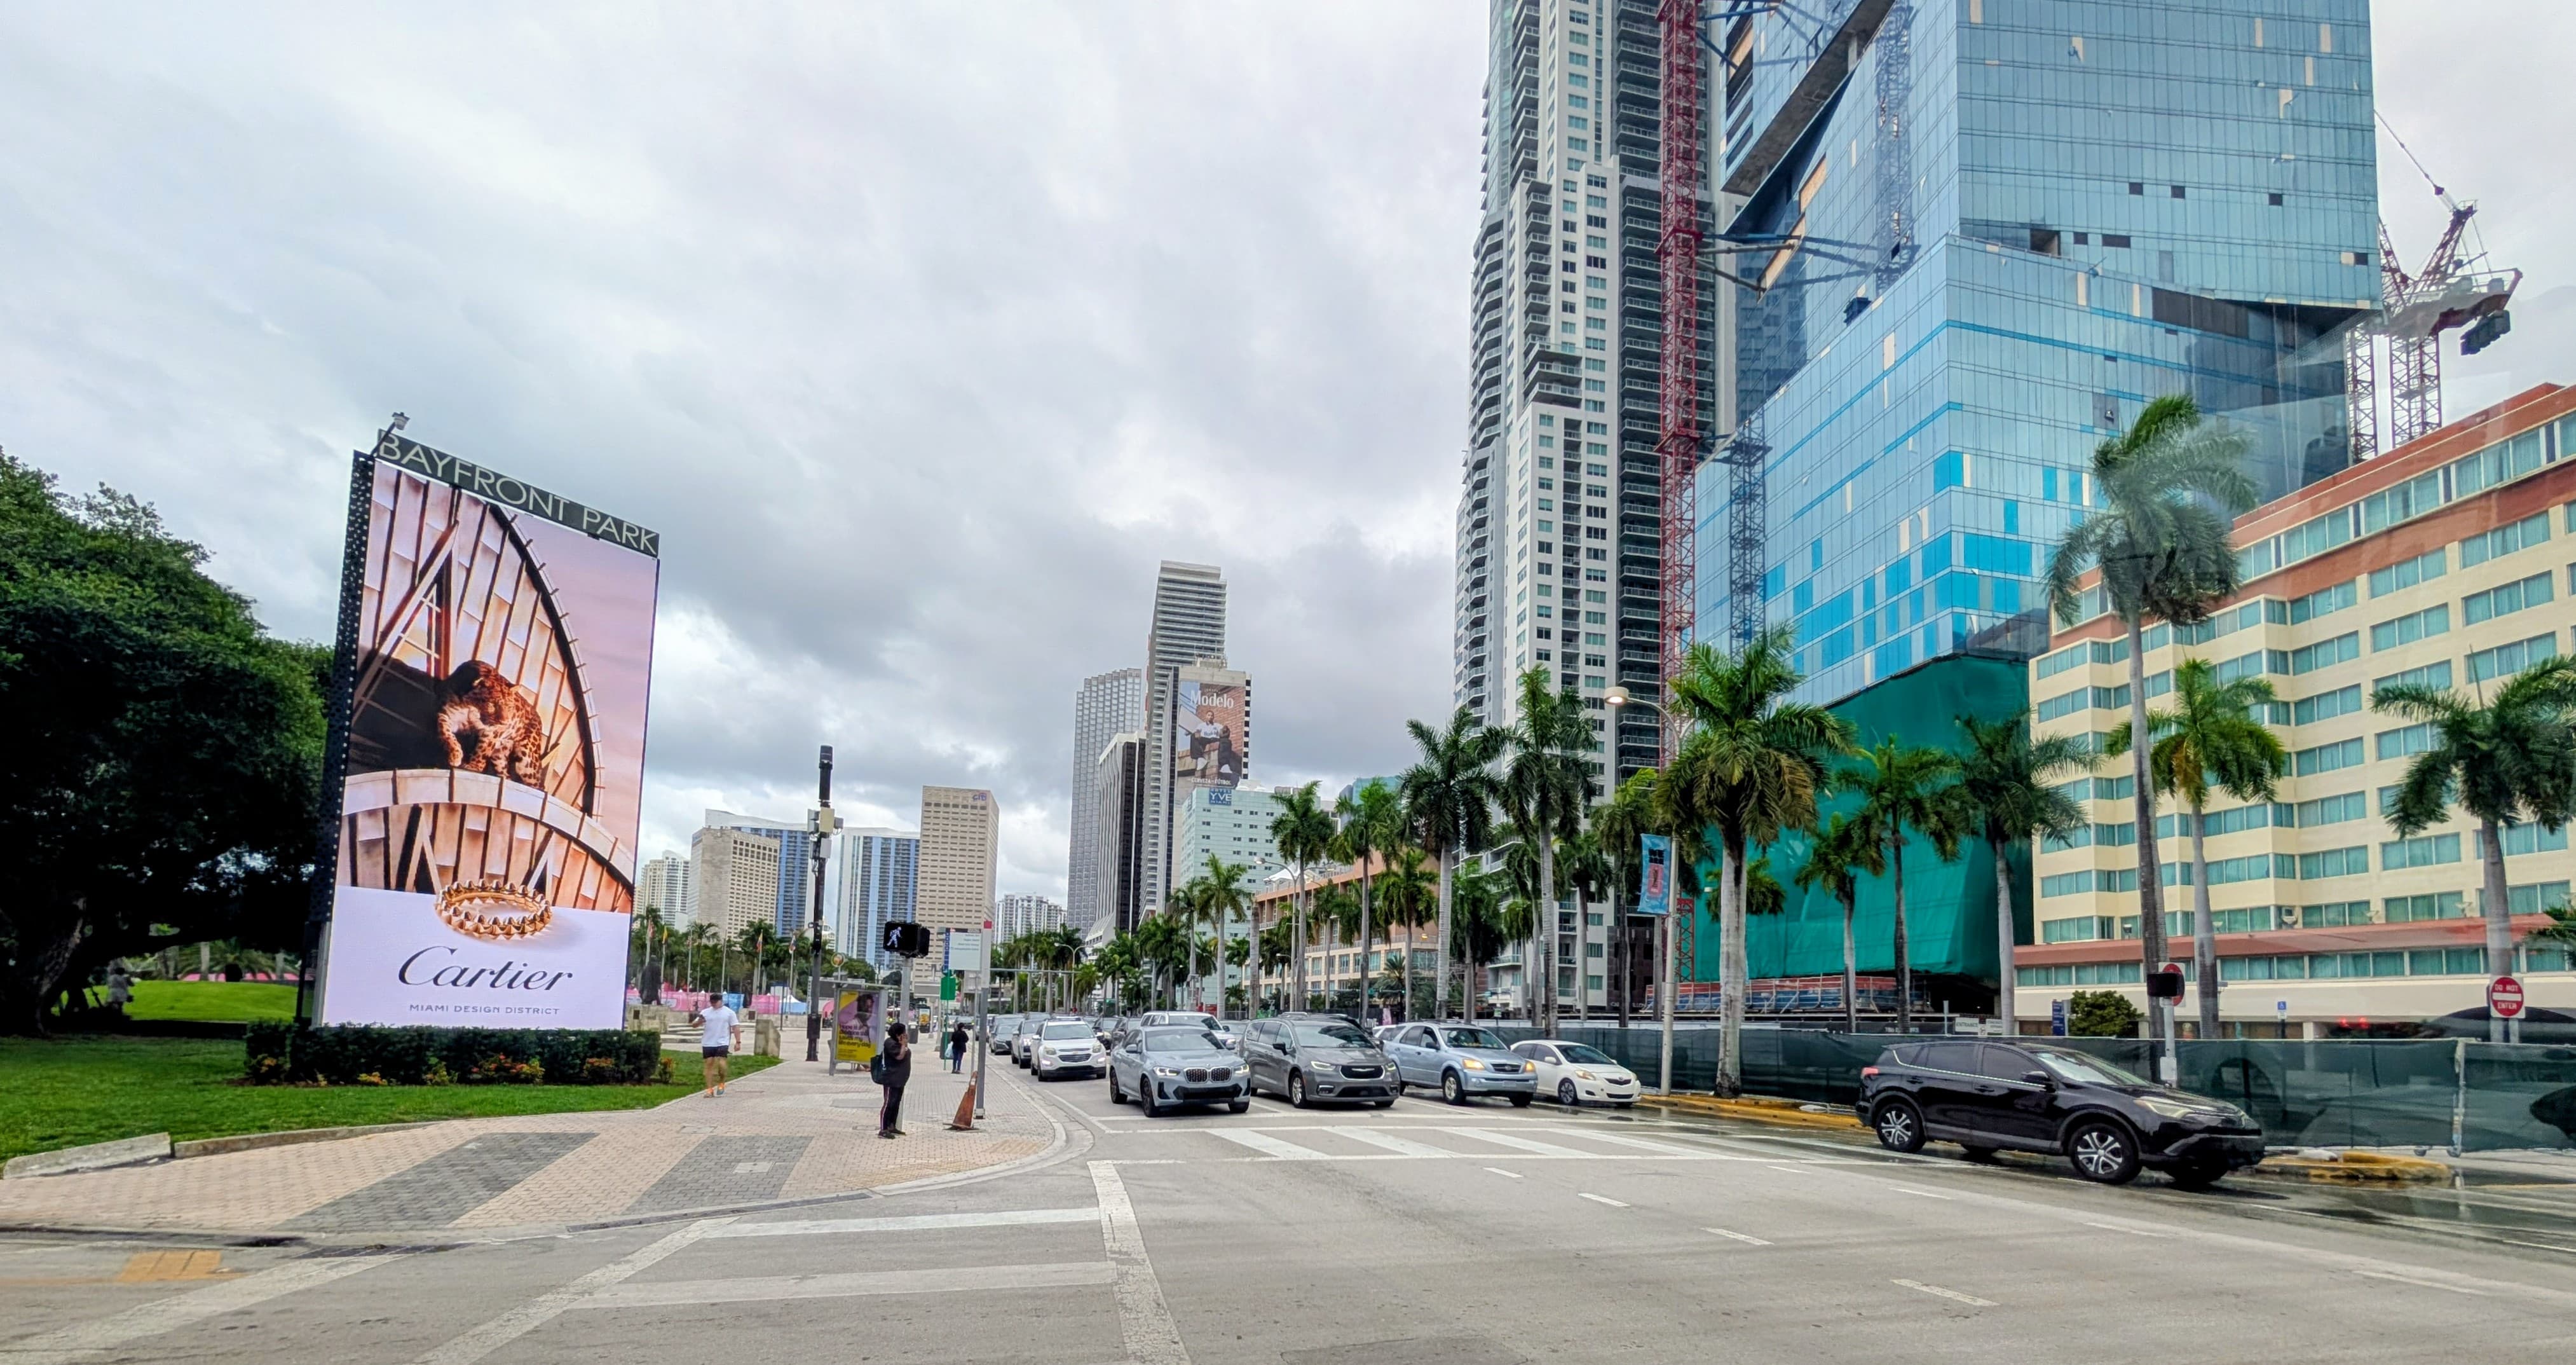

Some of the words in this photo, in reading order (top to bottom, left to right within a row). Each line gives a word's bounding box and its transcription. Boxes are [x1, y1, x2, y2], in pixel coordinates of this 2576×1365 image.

[379, 433, 569, 521] BAYFRONT
[583, 508, 657, 554] PARK
[1190, 690, 1234, 708] Modelo
[1210, 792, 1232, 801] YVE
[399, 946, 573, 991] Cartier
[505, 1006, 560, 1015] DISTRICT
